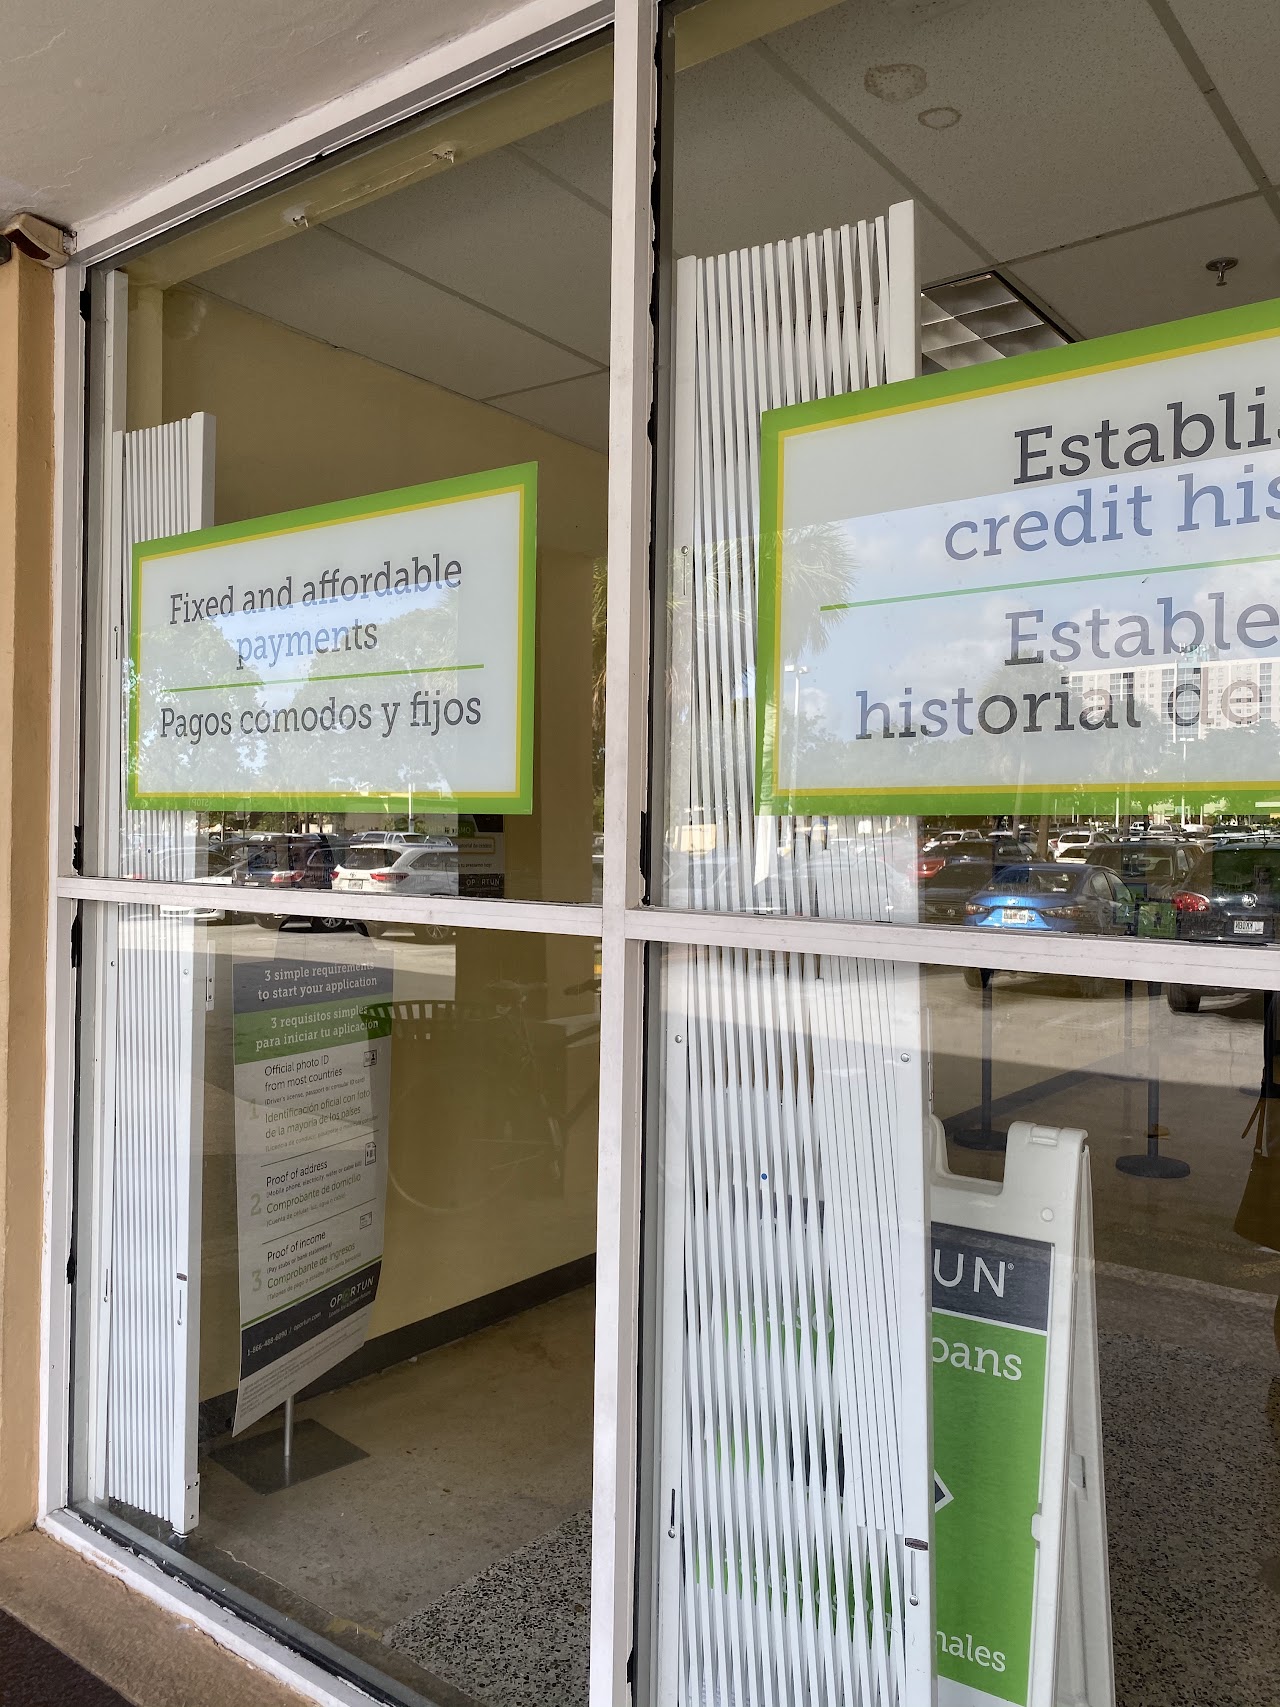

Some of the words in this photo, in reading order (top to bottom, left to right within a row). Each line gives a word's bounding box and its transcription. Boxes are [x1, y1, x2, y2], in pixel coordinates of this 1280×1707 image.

[1013, 385, 1280, 485] Establi
[944, 483, 1153, 561] credit
[169, 585, 234, 625] Fixed
[242, 576, 293, 614] and
[302, 553, 463, 607] affordable
[236, 618, 378, 670] payments
[1003, 591, 1280, 667] Estable
[160, 707, 232, 745] Pagos
[240, 696, 372, 736] cómodos
[381, 702, 402, 738] y
[409, 690, 482, 736] fijos
[855, 669, 1142, 741] historial
[1167, 664, 1263, 727] de
[466, 878, 500, 886] OPRTUN
[257, 989, 270, 1000] to
[272, 985, 297, 999] start
[300, 983, 324, 998] your
[325, 976, 378, 993] application
[264, 969, 271, 982] 3
[274, 966, 310, 981] simple
[312, 961, 375, 978] requirements
[271, 1017, 277, 1029] 3
[280, 1011, 331, 1028] requisitos
[333, 1004, 369, 1019] simples
[255, 1037, 281, 1052] para
[283, 1030, 318, 1045] iniciar
[320, 1027, 331, 1038] tu
[332, 1017, 379, 1038] aplicación
[264, 1062, 295, 1077] Official
[296, 1058, 320, 1073] photo
[321, 1054, 330, 1065] ID
[264, 1081, 286, 1092] from
[287, 1075, 308, 1088] most
[308, 1067, 343, 1083] countries
[249, 1098, 260, 1121] 1
[265, 1102, 320, 1124] Identificación
[320, 1096, 342, 1111] oficial
[342, 1093, 356, 1104] con
[356, 1089, 371, 1102] foto
[265, 1127, 276, 1139] de
[278, 1125, 285, 1137] la
[286, 1117, 318, 1134] mayoría
[318, 1113, 328, 1125] de
[329, 1110, 340, 1122] los
[341, 1104, 362, 1120] países
[266, 1169, 290, 1188] Proof
[290, 1167, 299, 1181] of
[299, 1160, 328, 1177] address
[250, 1192, 262, 1217] 2
[266, 1188, 320, 1214] Comprobante
[321, 1182, 331, 1194] de
[331, 1172, 362, 1191] domicilio
[267, 1243, 290, 1262] Proof
[290, 1240, 299, 1253] of
[299, 1231, 326, 1249] income
[251, 1268, 263, 1292] 3
[267, 1260, 319, 1289] Comprobante
[319, 1254, 328, 1266] de
[329, 1241, 356, 1262] ingresos
